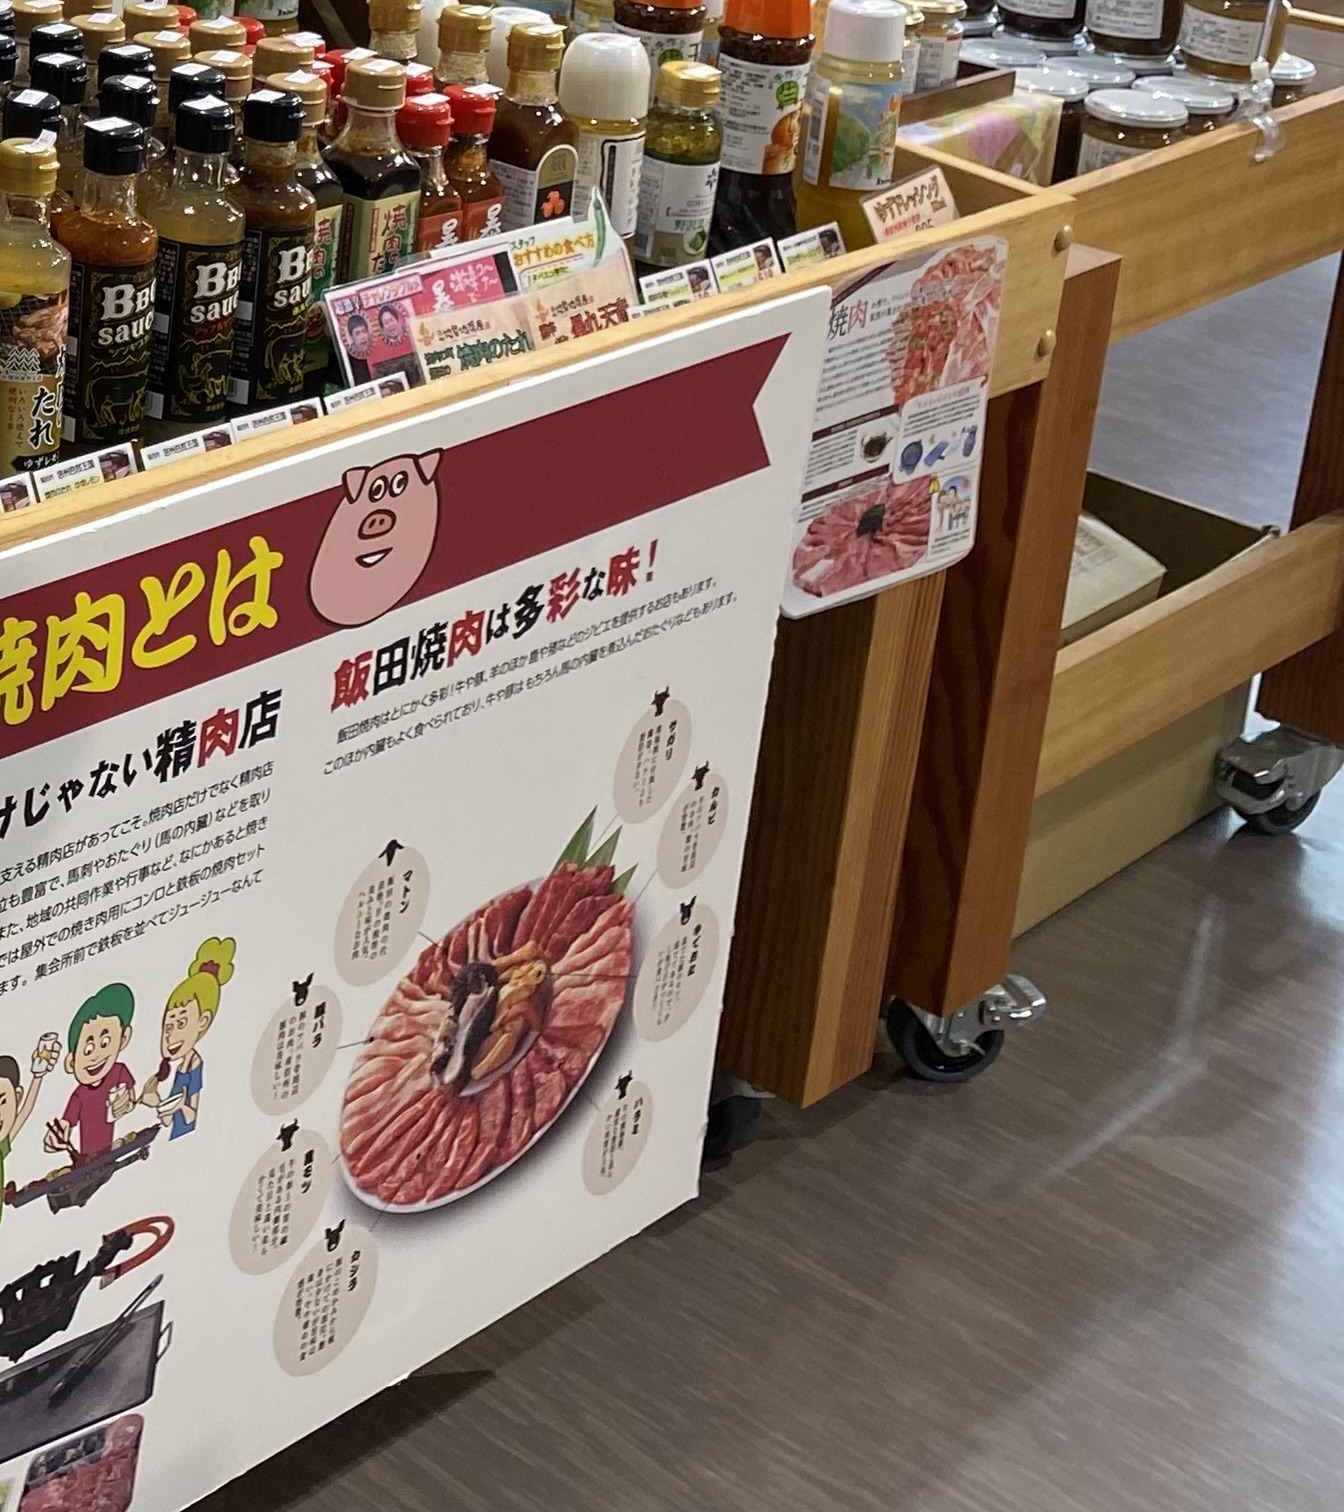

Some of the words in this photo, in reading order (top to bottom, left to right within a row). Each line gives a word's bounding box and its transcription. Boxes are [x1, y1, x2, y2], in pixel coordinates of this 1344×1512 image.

[828, 299, 870, 340] 焼肉
[330, 539, 659, 713] 飯田焼肉は多彩な味！
